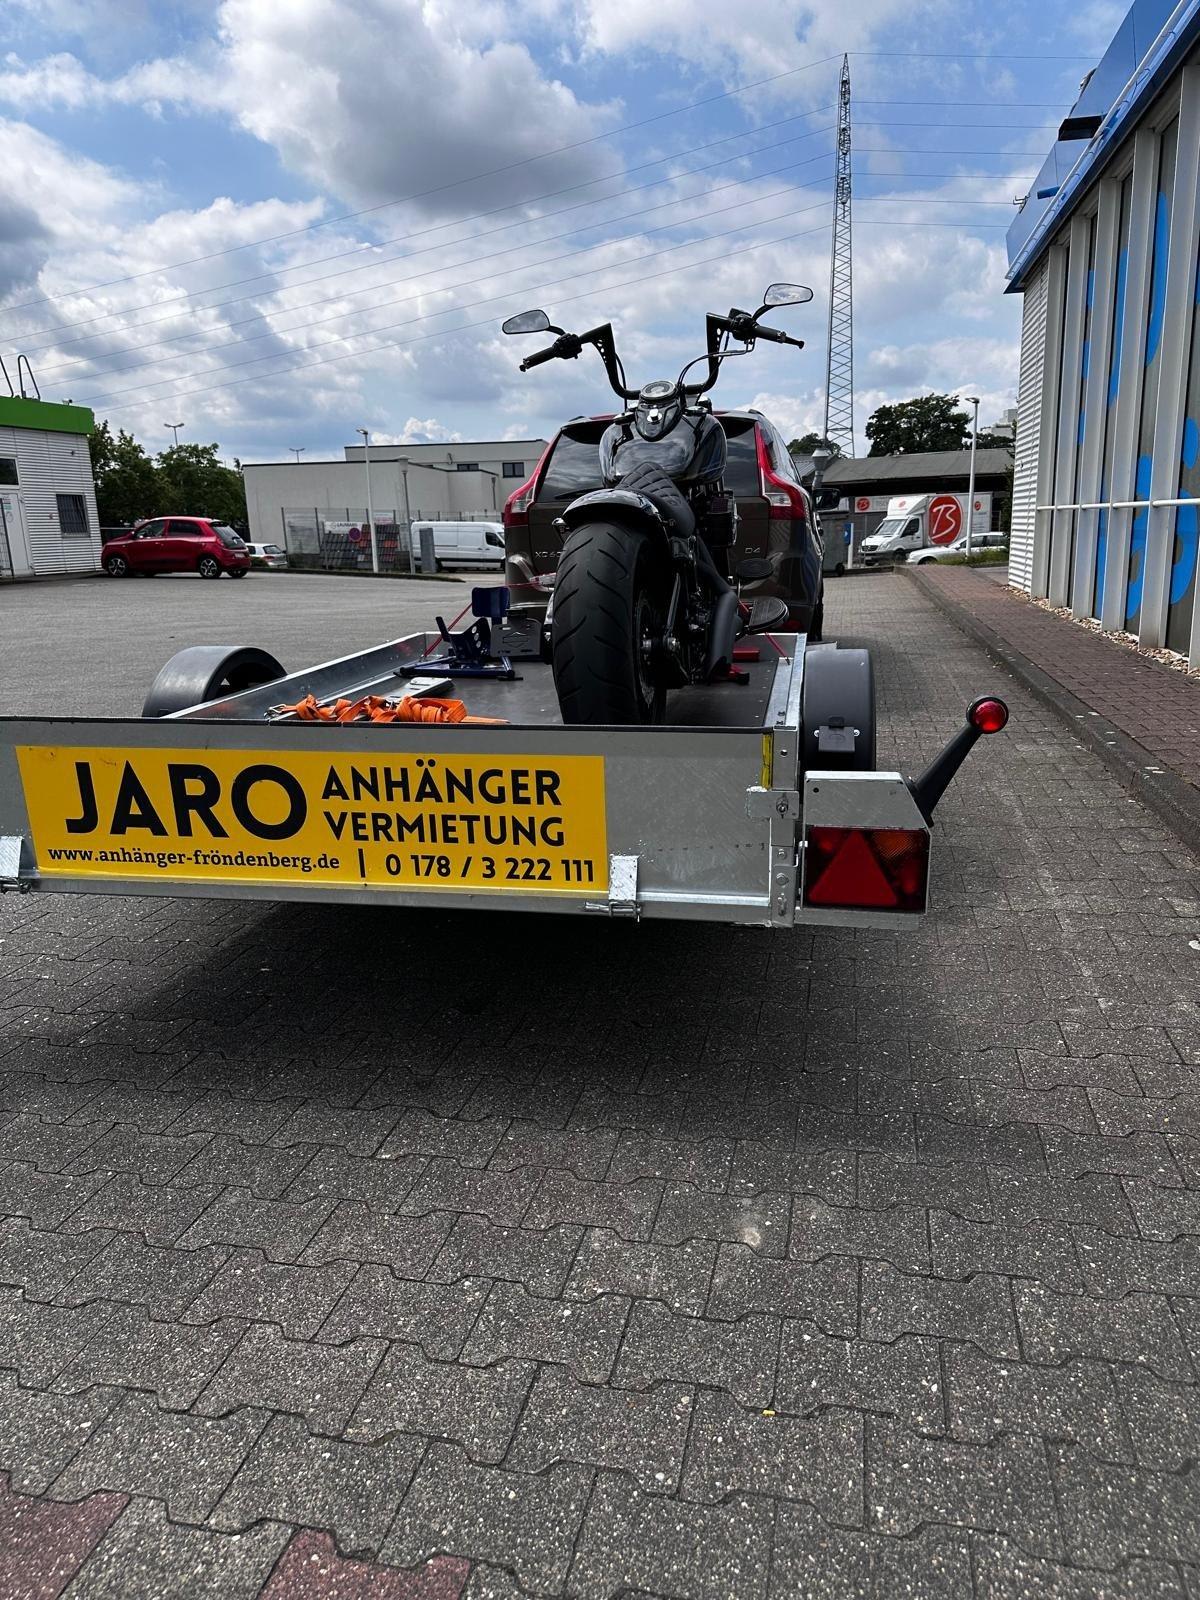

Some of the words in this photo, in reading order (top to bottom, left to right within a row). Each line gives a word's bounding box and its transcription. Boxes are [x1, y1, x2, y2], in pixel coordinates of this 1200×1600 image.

[66, 760, 307, 840] JARO
[321, 758, 562, 806] ANHÄNGER
[323, 811, 565, 847] VERMIETUNG
[48, 848, 340, 872] www.anhänger-fröndenberg.de
[385, 853, 401, 876] 0
[410, 854, 451, 877] 178
[481, 856, 496, 879] 3
[505, 857, 552, 881] 222
[561, 859, 594, 882] 111
